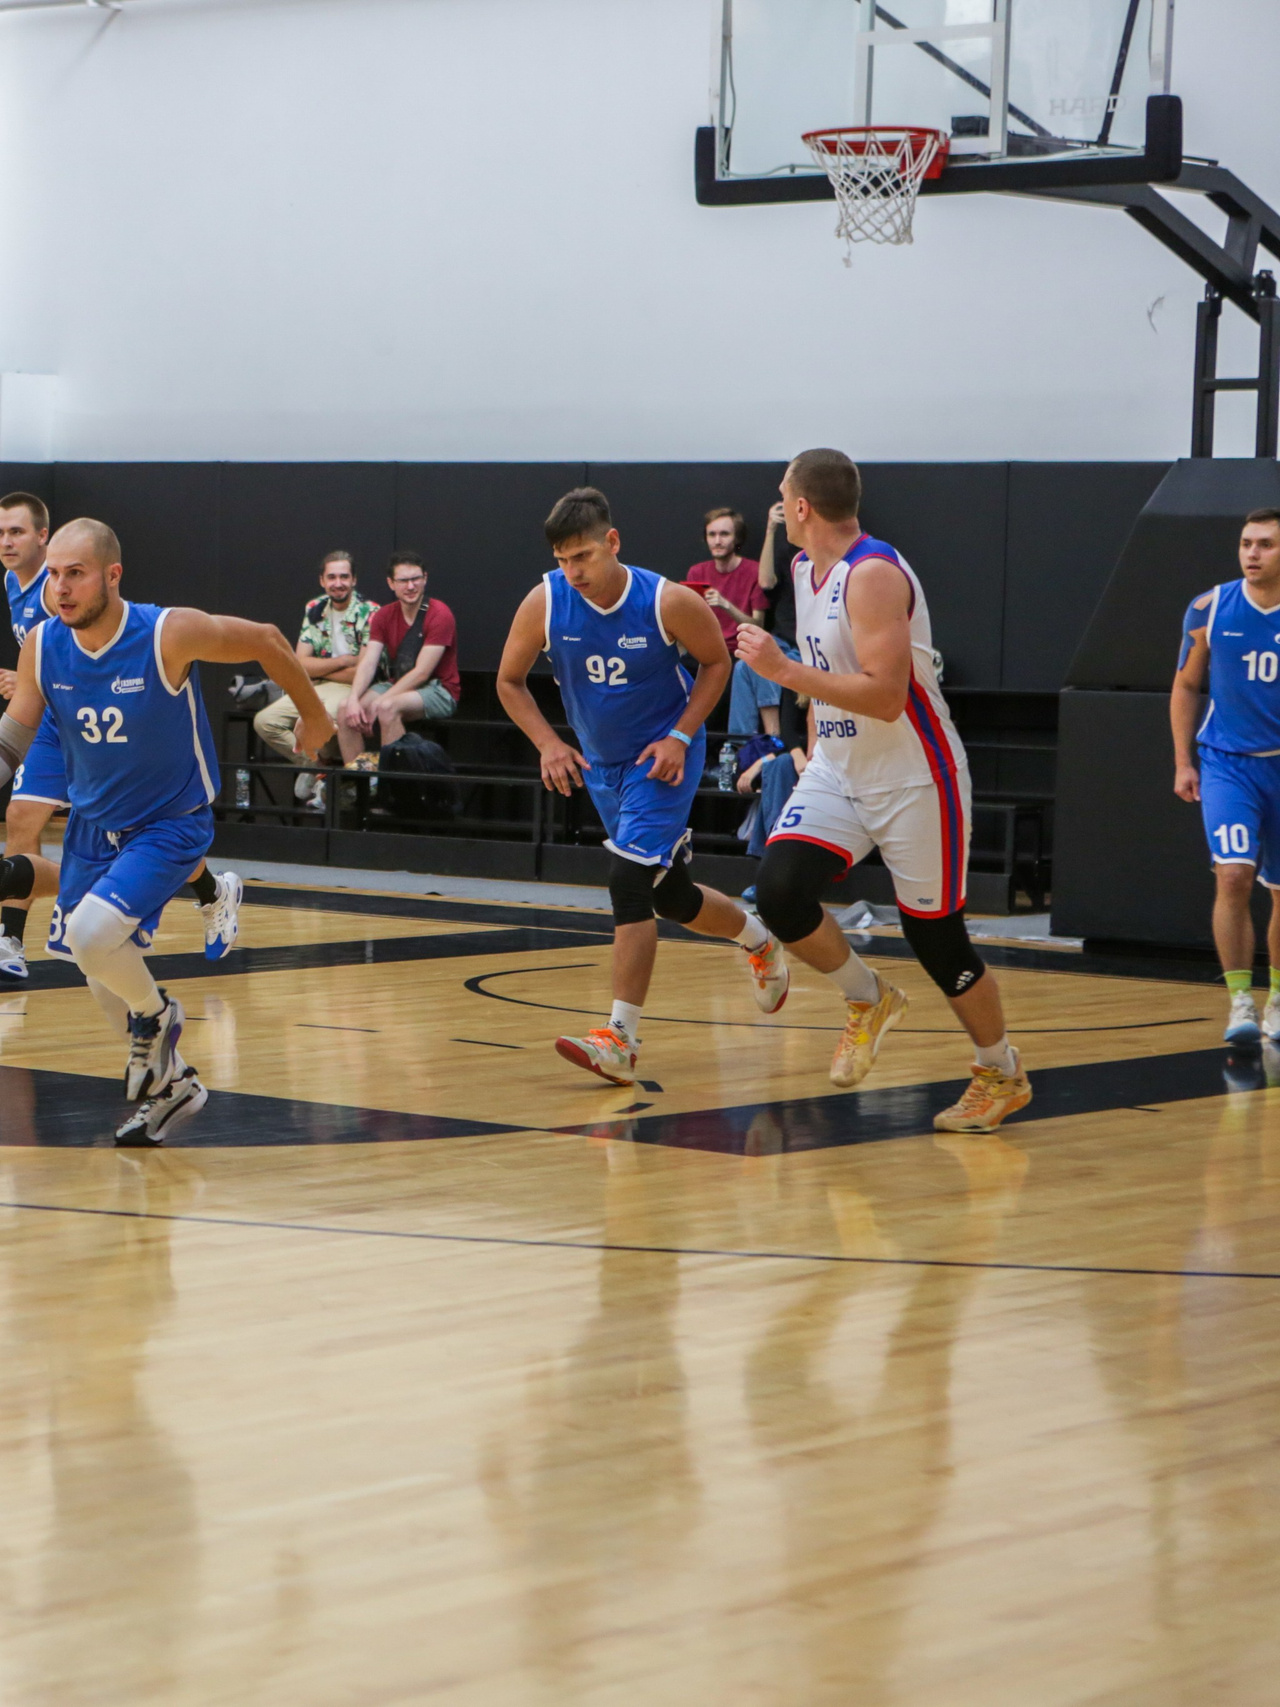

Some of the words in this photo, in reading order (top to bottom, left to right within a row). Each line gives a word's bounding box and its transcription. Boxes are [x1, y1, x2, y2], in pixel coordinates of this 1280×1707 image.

[806, 635, 830, 672] 15
[1242, 650, 1278, 683] 10
[585, 655, 628, 686] 92
[76, 706, 128, 744] 32
[1213, 823, 1249, 854] 10
